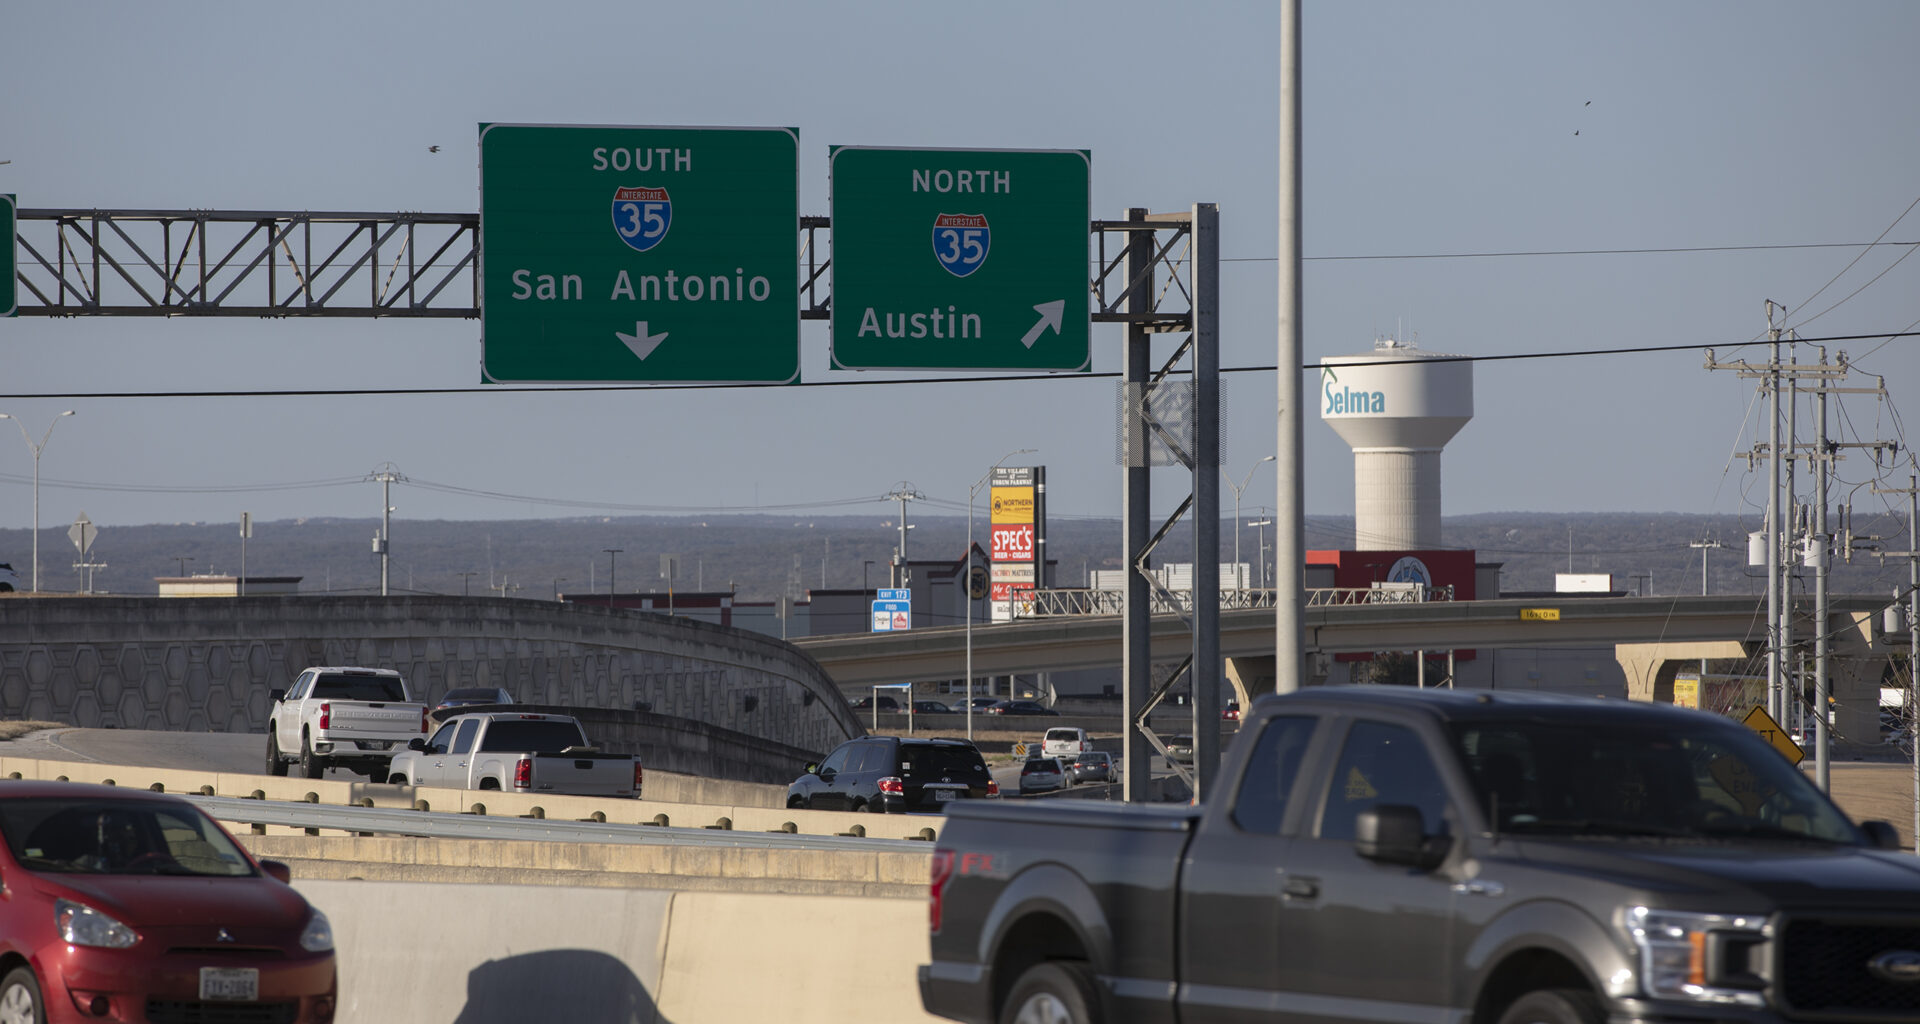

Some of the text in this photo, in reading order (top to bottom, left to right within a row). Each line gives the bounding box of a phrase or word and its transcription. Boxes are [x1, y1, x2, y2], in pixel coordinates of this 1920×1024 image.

[592, 147, 692, 172] SOUTH
[912, 169, 1010, 194] NORTH
[621, 191, 662, 200] INTERSTATE
[619, 203, 665, 238] 35
[941, 217, 982, 227] INTERSTATE
[939, 229, 984, 264] 35
[511, 267, 771, 302] San Antonio
[857, 305, 982, 339] Austin
[1325, 381, 1385, 415] Selma
[993, 525, 1032, 551] SPEC'S
[994, 551, 1032, 559] BEER CIGARS
[895, 590, 907, 599] 173
